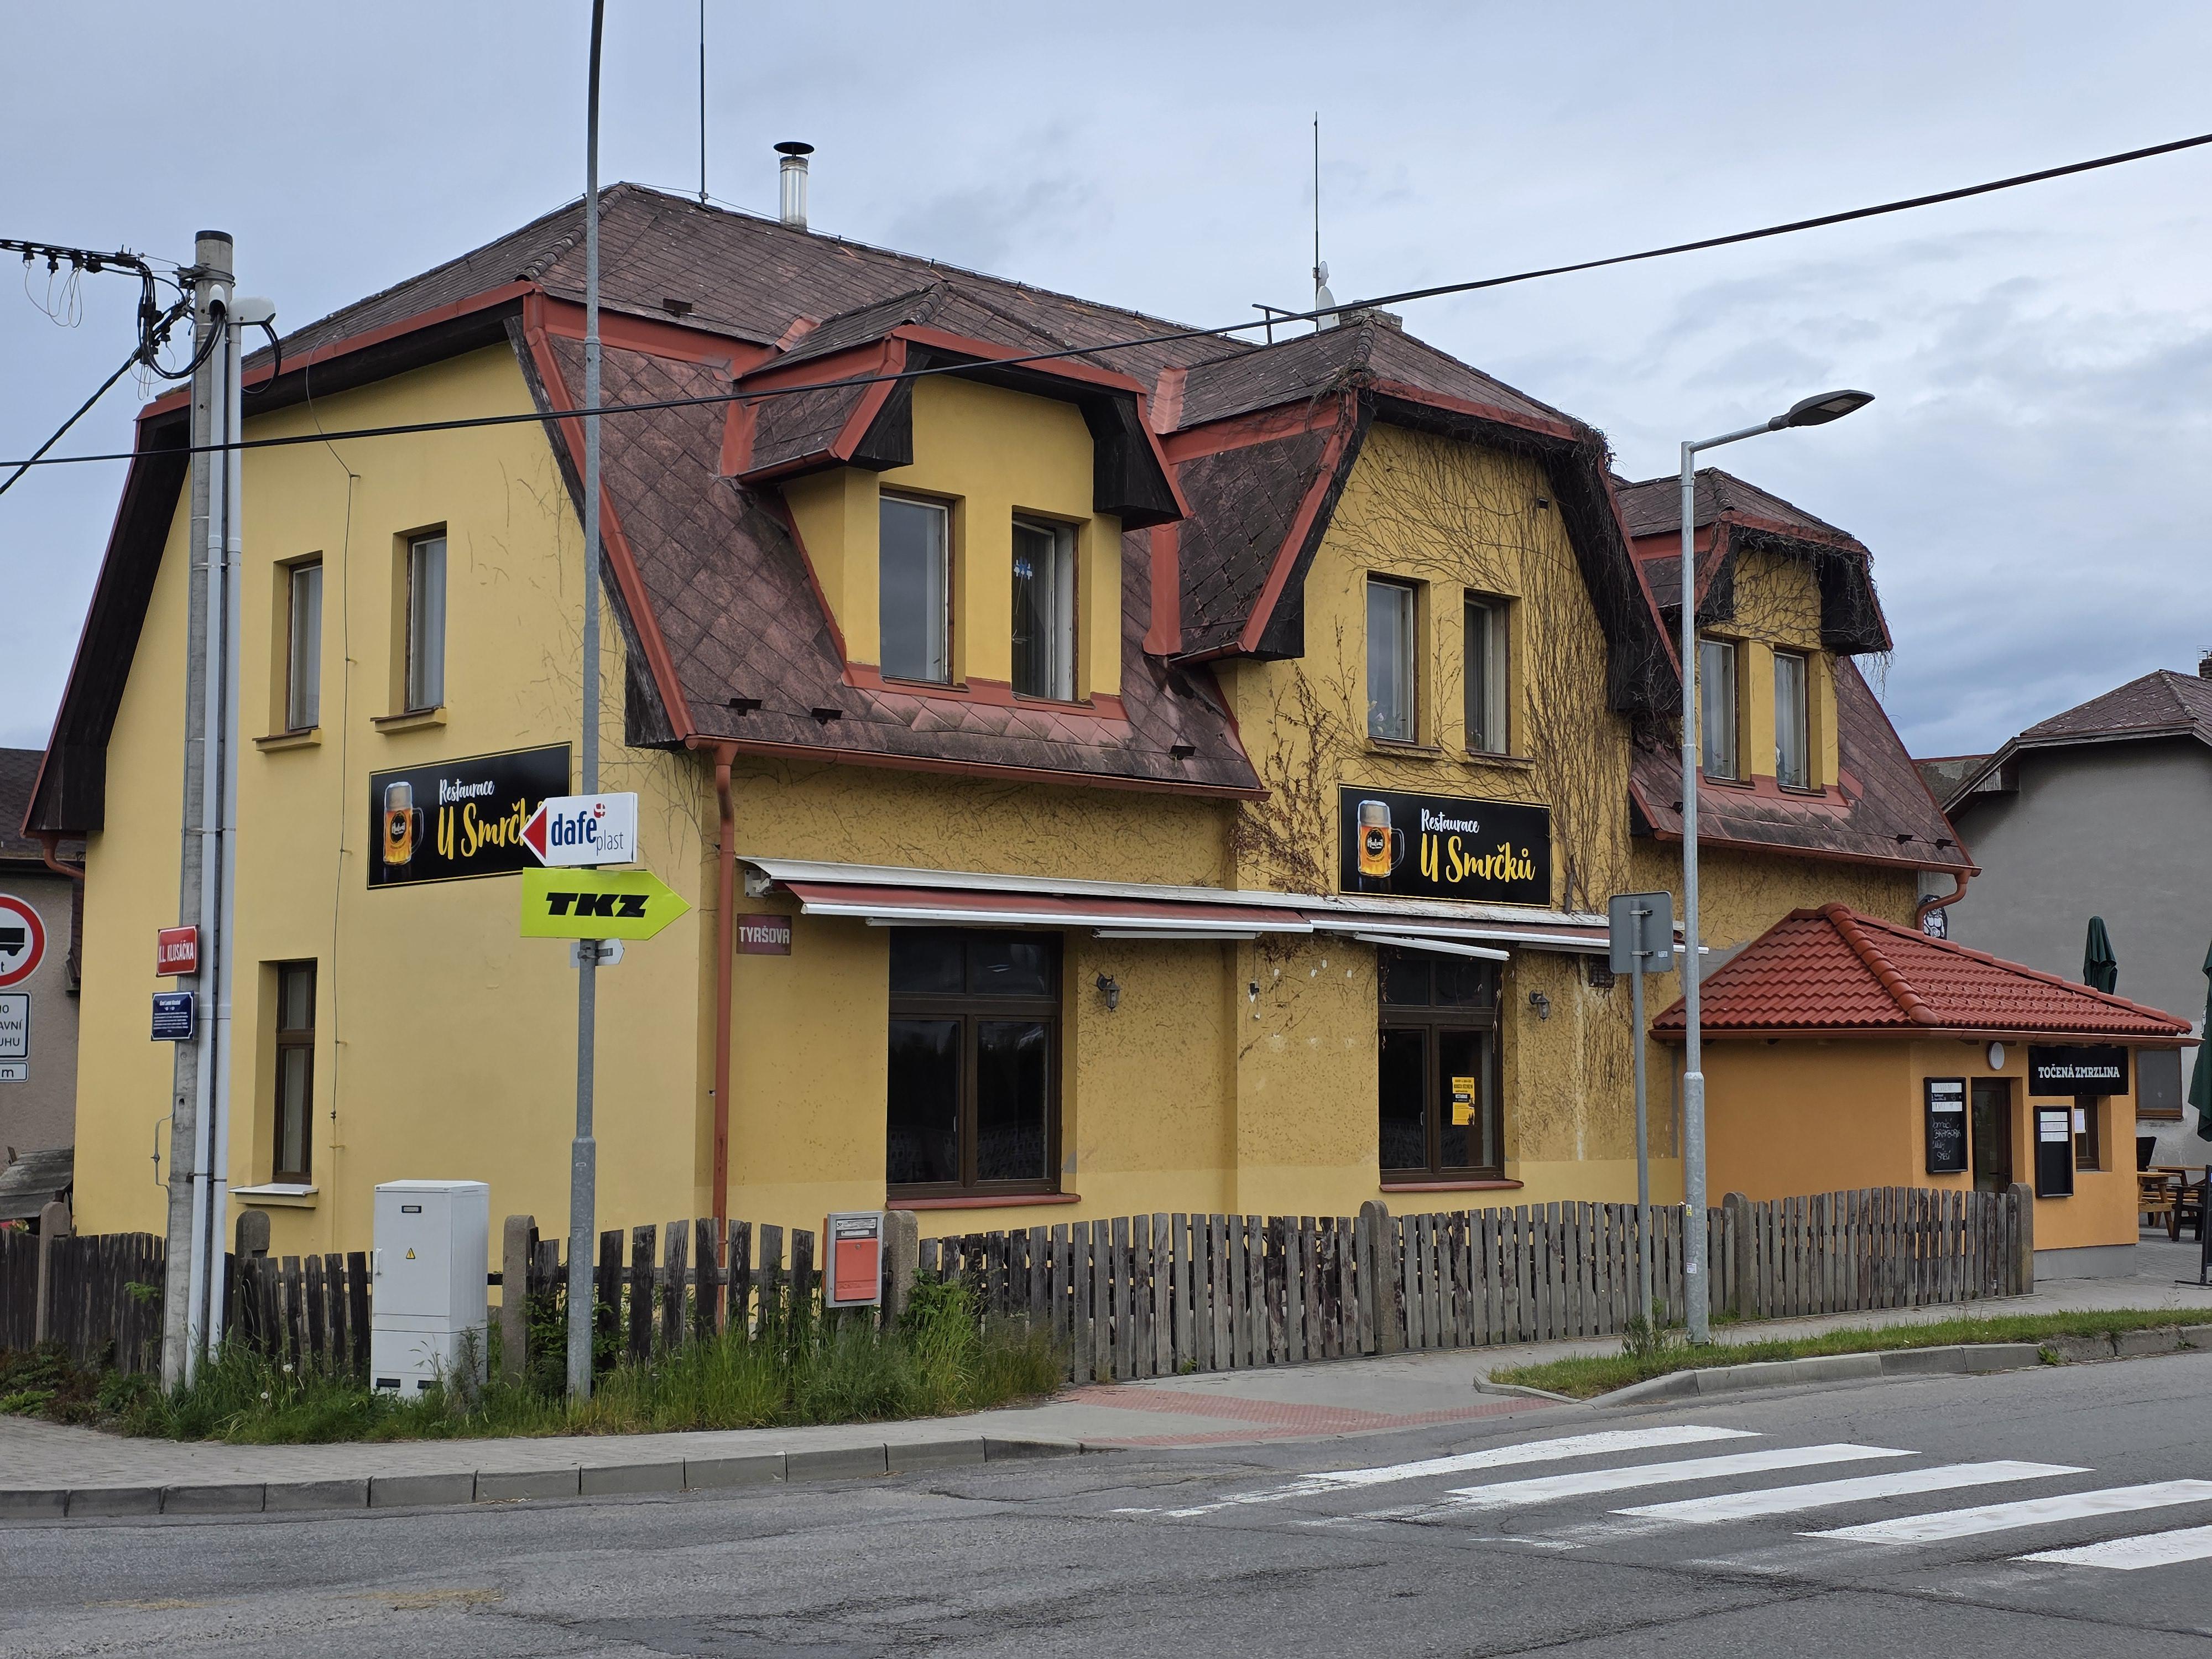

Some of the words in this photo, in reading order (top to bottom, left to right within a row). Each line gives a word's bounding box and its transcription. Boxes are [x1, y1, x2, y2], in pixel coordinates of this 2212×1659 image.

[440, 779, 495, 805] Restaurace
[437, 806, 454, 860] U
[461, 797, 543, 857] Smrčk
[551, 811, 597, 846] dafe
[1421, 808, 1480, 833] Restaurace
[596, 830, 624, 856] plast
[1421, 833, 1438, 882] U
[1446, 836, 1536, 883] Smrčků
[546, 892, 650, 918] TKZ
[739, 925, 790, 944] TYRŠOVA
[167, 940, 194, 962] KLUSÁČKA
[2038, 1063, 2075, 1078] TOČENÁ
[2075, 1066, 2120, 1078] ZMRZLINA
